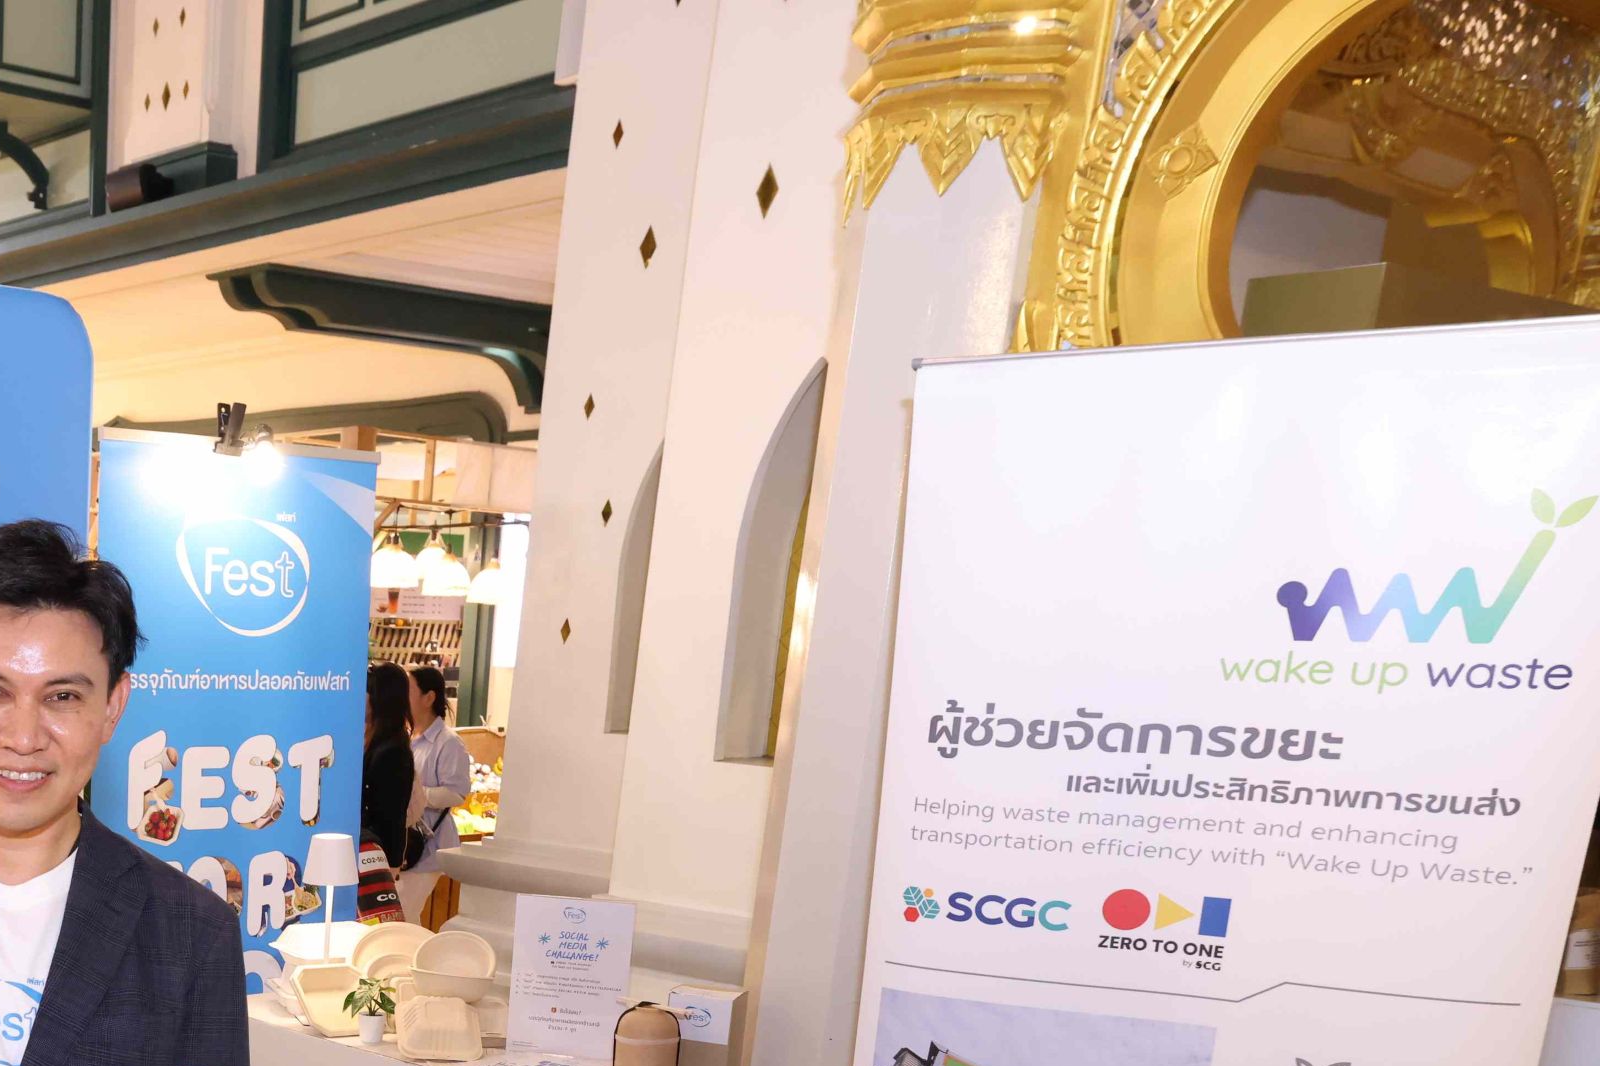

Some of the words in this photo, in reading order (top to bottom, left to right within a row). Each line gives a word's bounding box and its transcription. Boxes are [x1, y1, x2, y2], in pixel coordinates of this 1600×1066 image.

[204, 546, 296, 599] Fest
[130, 668, 351, 696] รรจุภัณฑ์อาหารปลอดภัยเฟสท์
[1219, 650, 1335, 686] wake
[1350, 661, 1409, 694] up
[1426, 658, 1574, 690] waste
[928, 699, 1345, 761] ผู้ช่วยจัดการขยะ
[127, 730, 335, 832] FEST
[1066, 764, 1522, 817] และเพิ่มประสิทธิภาพการขนส่ง
[914, 797, 995, 823] Helping
[1003, 806, 1071, 824] waste
[1078, 808, 1245, 835] management
[1254, 819, 1302, 840] and
[1311, 824, 1459, 855] enhancing
[910, 825, 1073, 853] transportation
[1082, 838, 1202, 867] efficiency
[1212, 847, 1267, 868] with
[1371, 859, 1410, 884] Up
[166, 850, 293, 936] OR
[946, 891, 1072, 932] SCGC
[559, 931, 591, 941] SOCIAL
[559, 941, 588, 950] MEDIA
[1098, 935, 1147, 951] ZERO
[1153, 939, 1178, 954] TO
[1183, 943, 1224, 959] ONE
[1195, 960, 1221, 971] SCG
